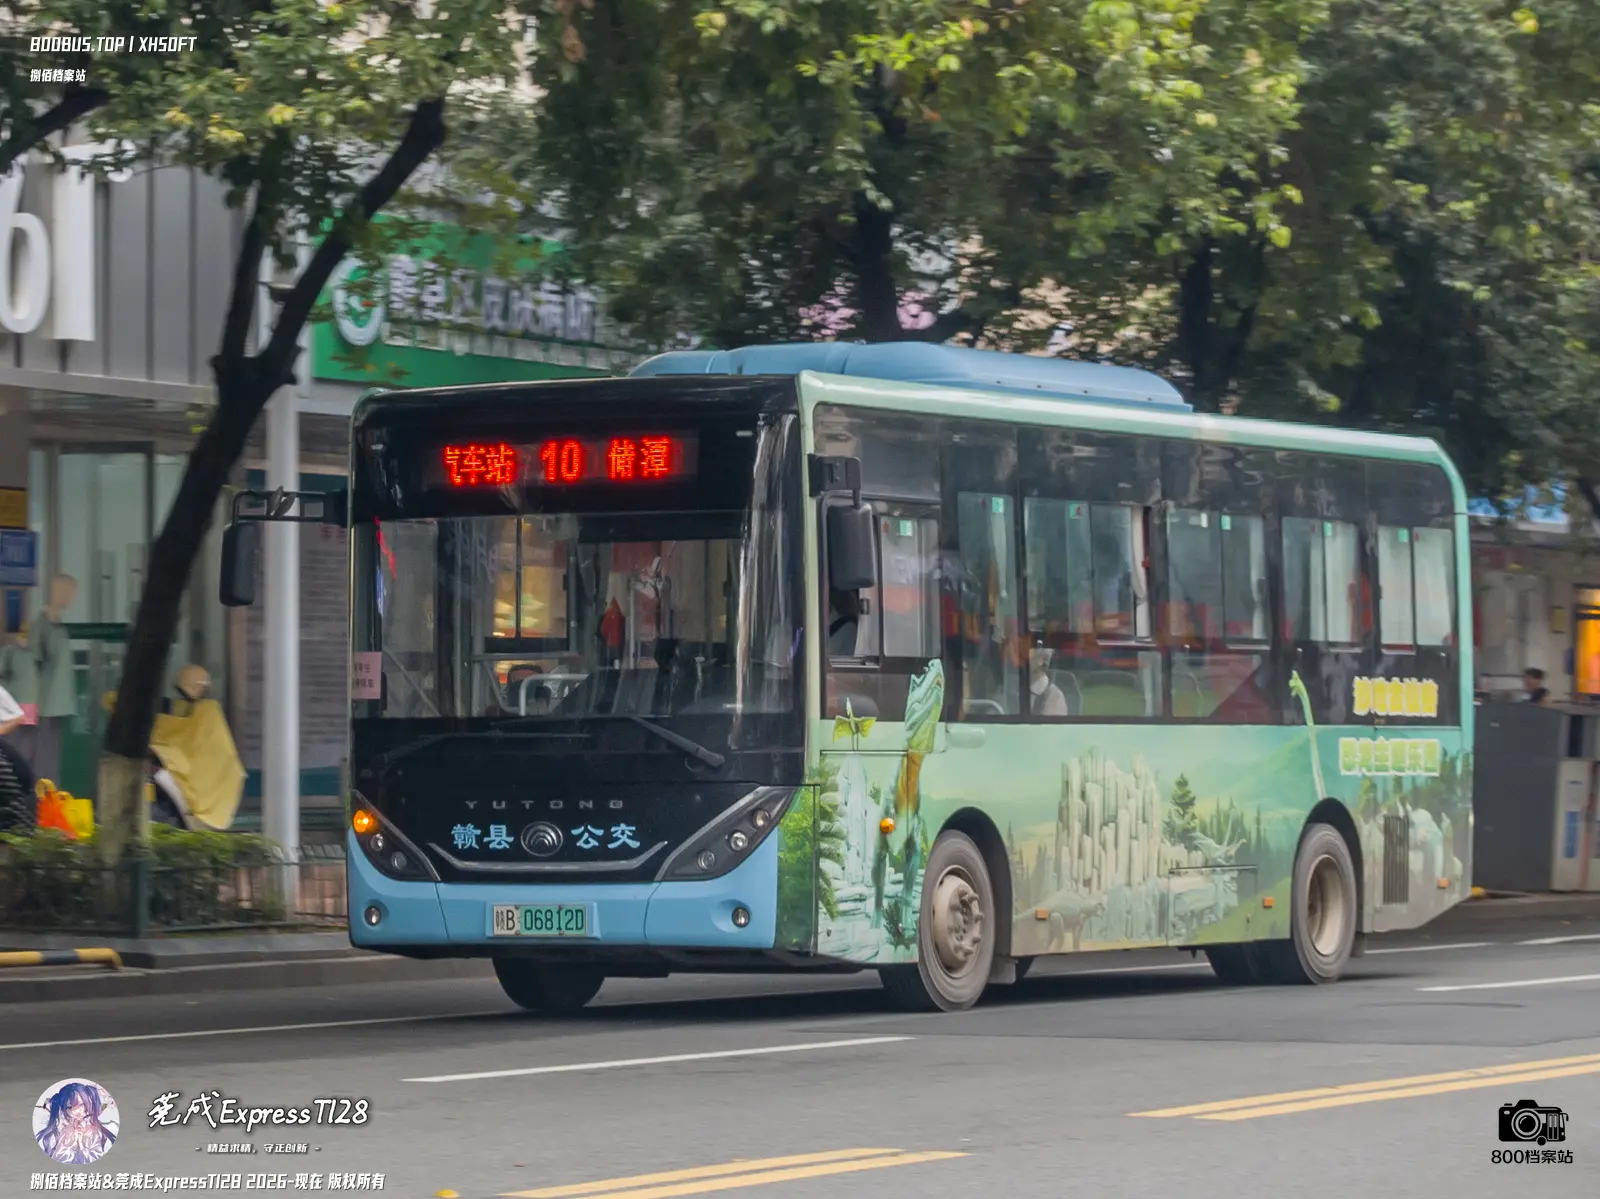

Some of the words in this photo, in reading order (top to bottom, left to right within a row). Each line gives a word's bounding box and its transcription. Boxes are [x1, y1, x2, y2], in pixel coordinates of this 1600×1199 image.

[541, 440, 581, 484] 10
[465, 800, 623, 809] YUTONG
[451, 823, 514, 849] 赣县
[571, 823, 641, 849] 公交
